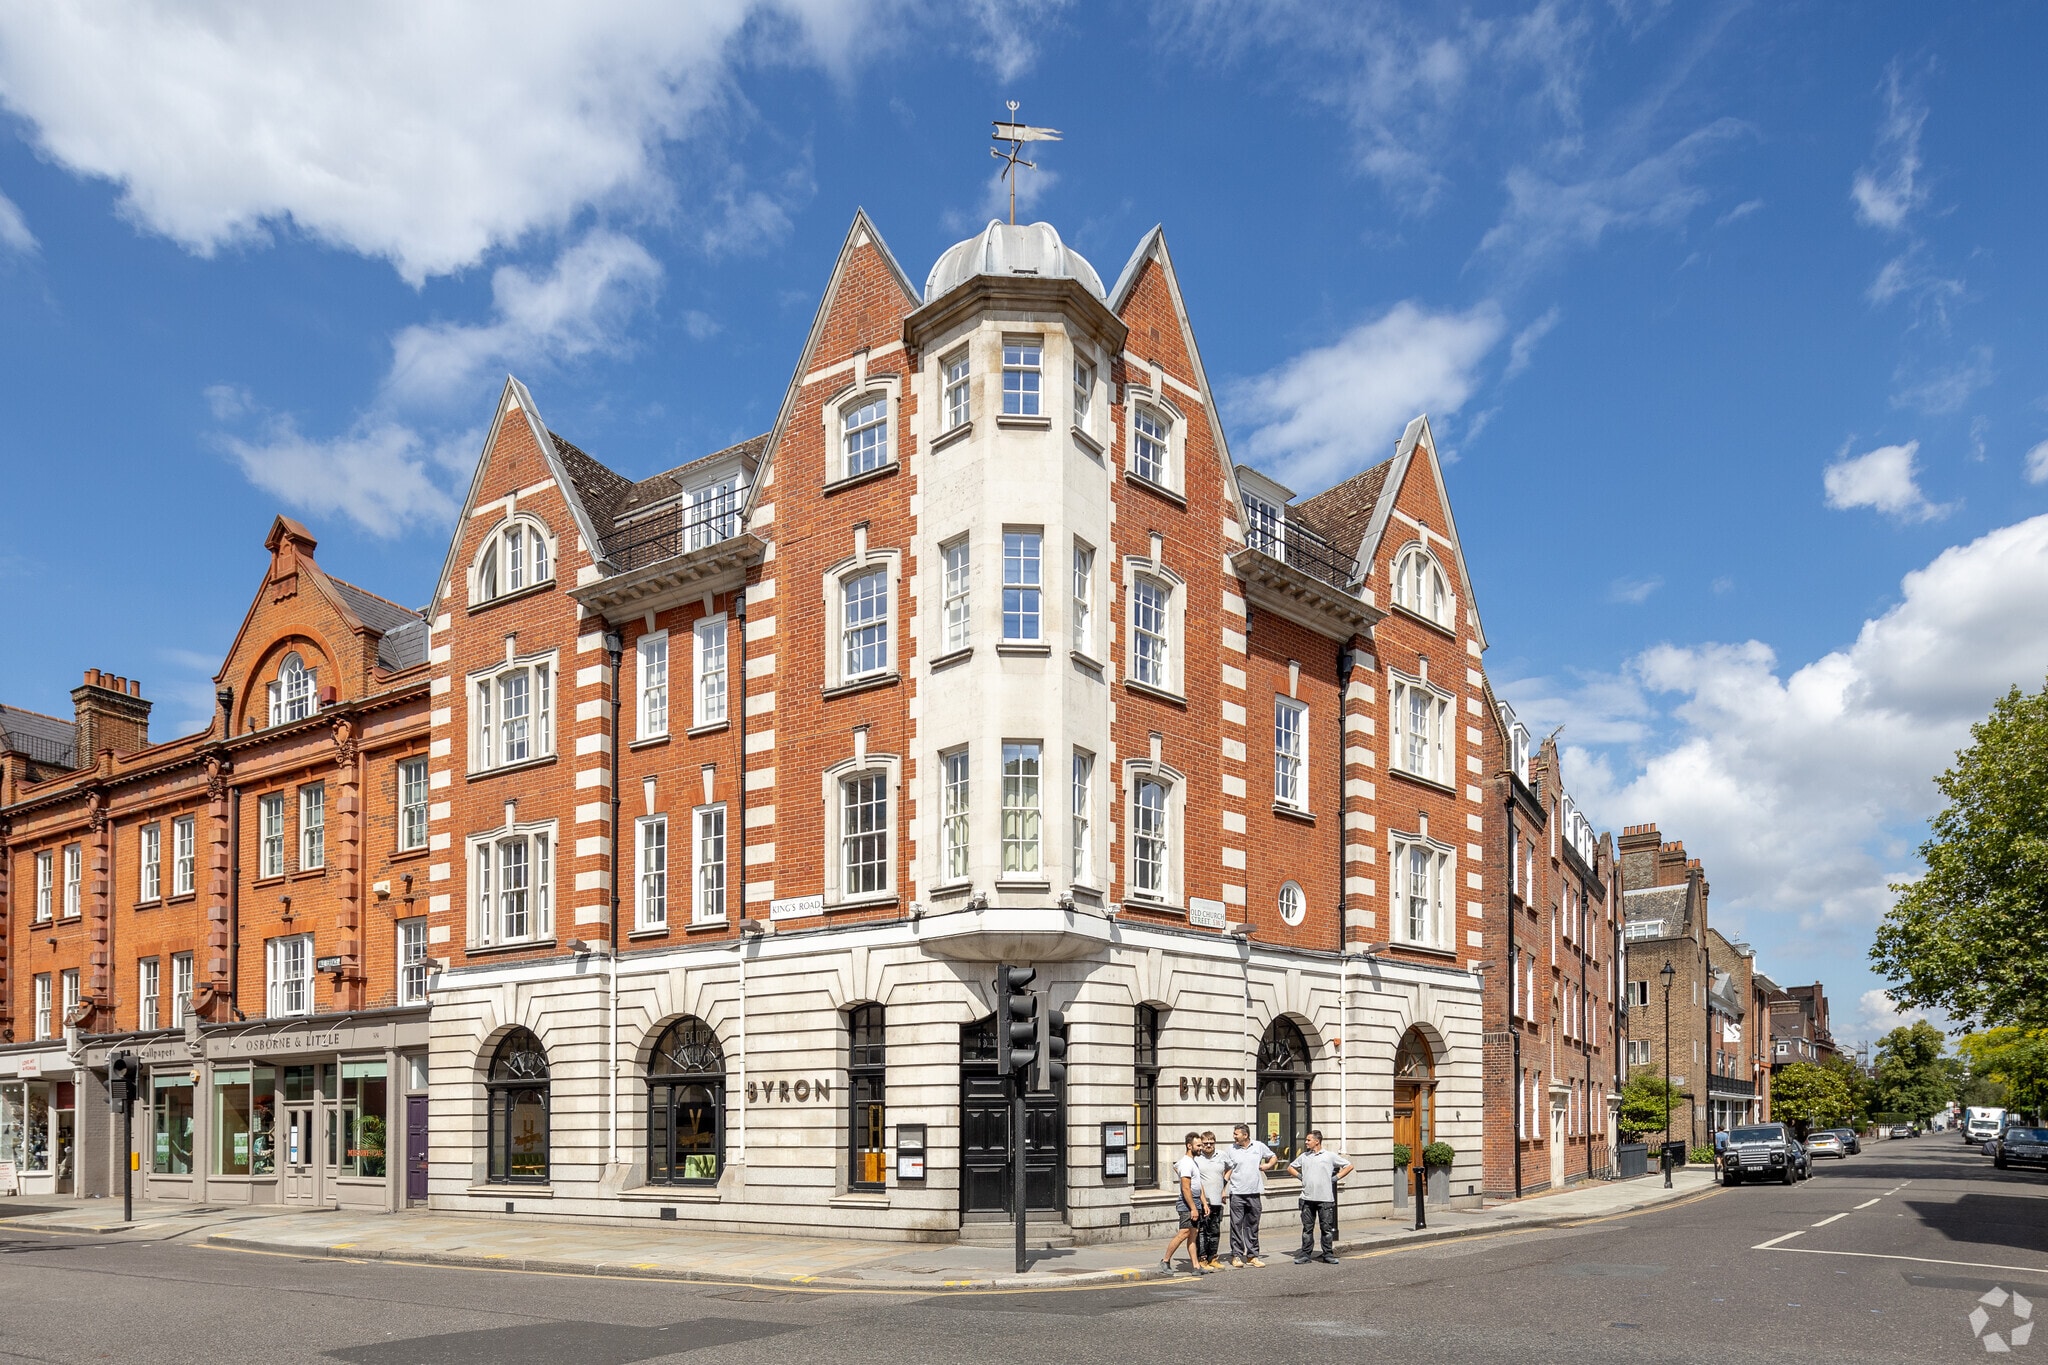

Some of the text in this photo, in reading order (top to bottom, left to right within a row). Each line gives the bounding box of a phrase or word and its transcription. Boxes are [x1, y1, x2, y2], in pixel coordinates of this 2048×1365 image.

[772, 900, 821, 914] KING'S ROAD
[1203, 911, 1224, 920] CHURCH
[246, 1033, 340, 1051] OSBORNE & LITTLE
[747, 1078, 831, 1103] BYRON
[1179, 1076, 1245, 1100] BYRON
